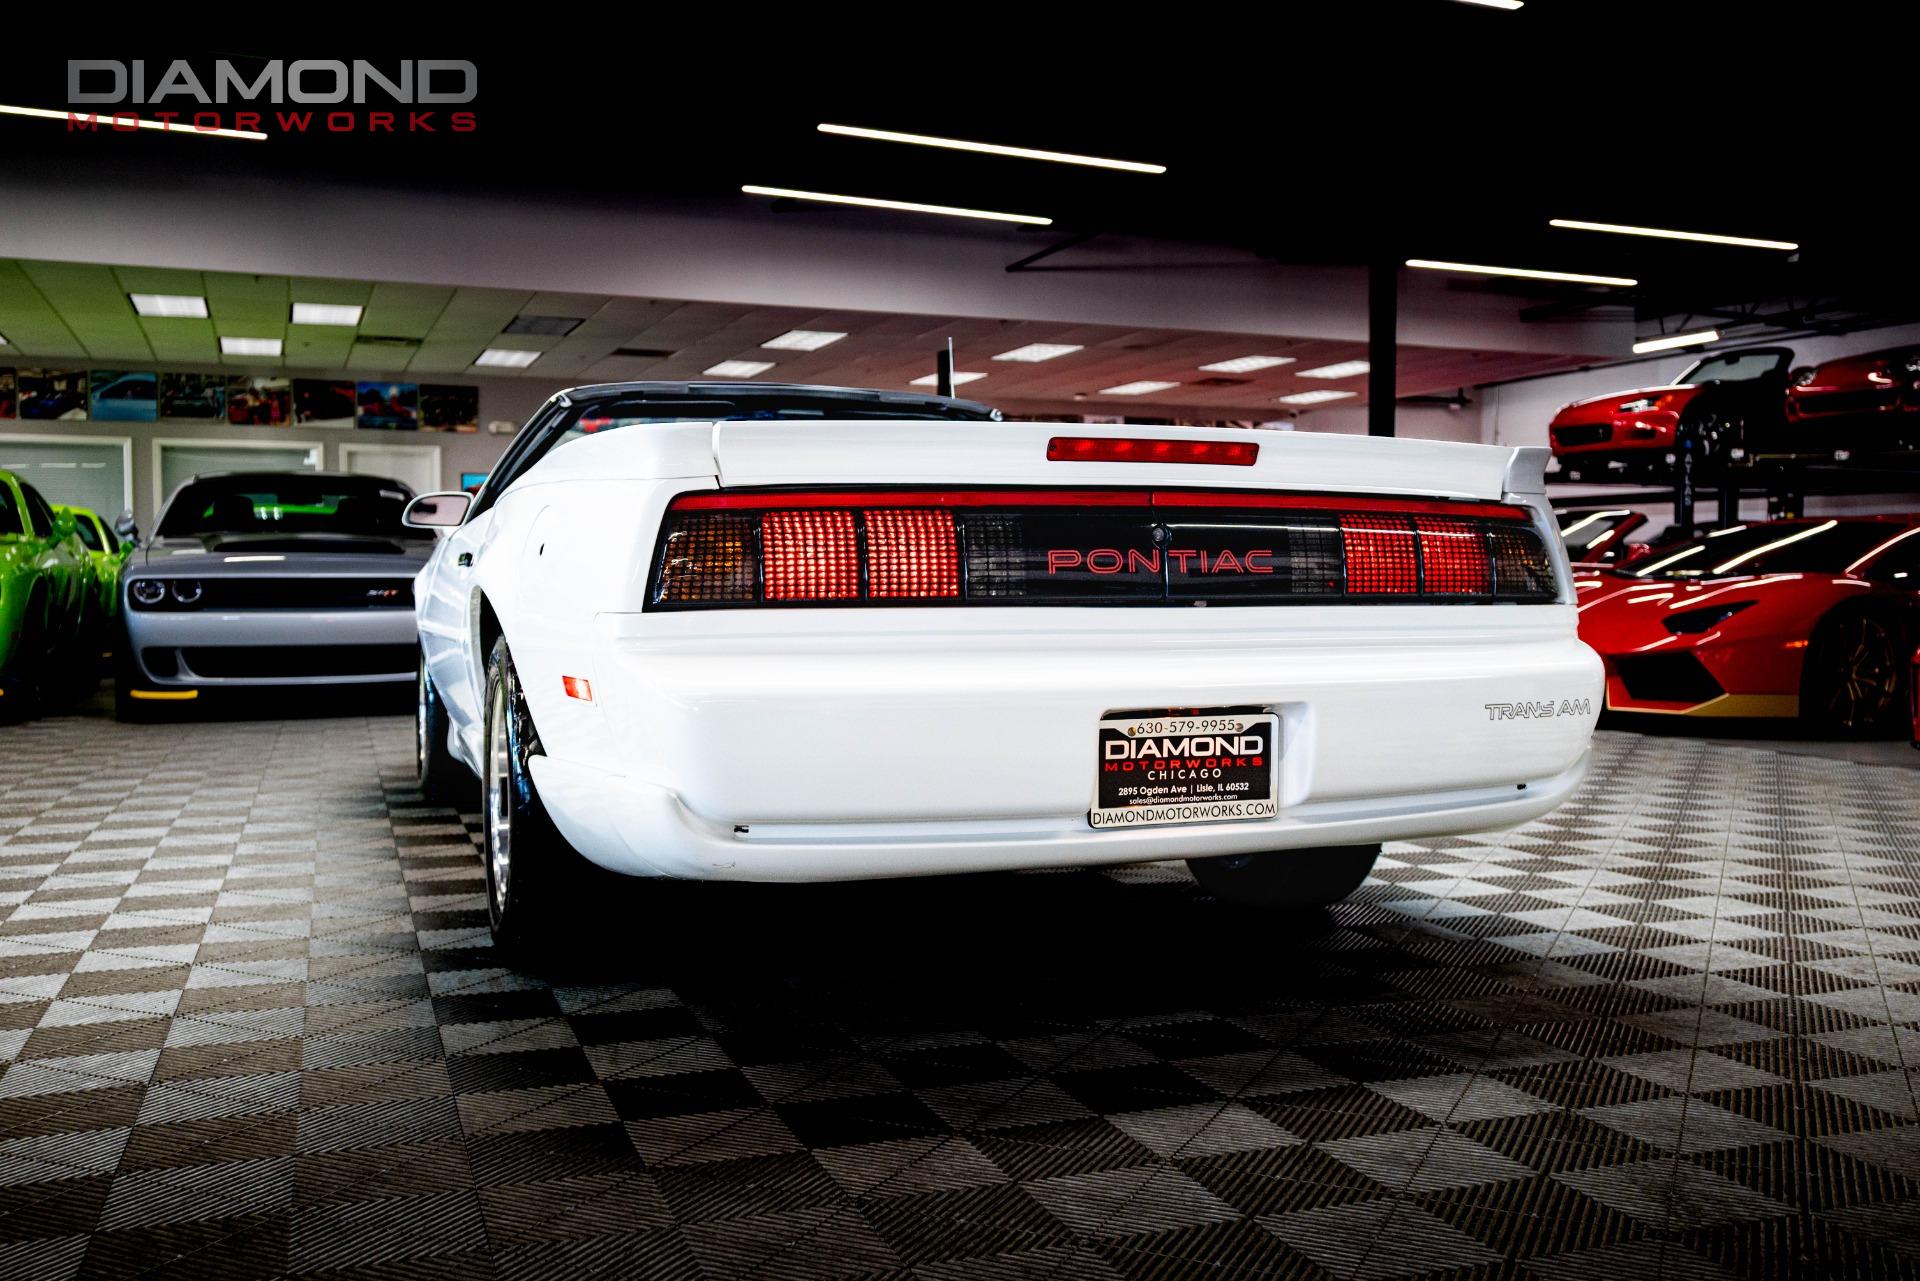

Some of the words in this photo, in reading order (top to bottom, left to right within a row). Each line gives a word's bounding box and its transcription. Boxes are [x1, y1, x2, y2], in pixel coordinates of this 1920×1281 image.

[1047, 549, 1273, 575] PONTIAC
[1485, 700, 1555, 720] TRANS
[1557, 698, 1591, 716] AM
[1136, 719, 1235, 735] 630-579-9955
[1105, 735, 1264, 760] DIAMOND
[1104, 756, 1263, 772] MOTORWORKS
[1147, 768, 1222, 781] CHICAGO
[1118, 787, 1138, 796] 2895
[1139, 785, 1169, 797] Ogden
[1170, 784, 1187, 794] Ave
[1196, 783, 1215, 793] Lisle,
[1217, 782, 1225, 791] IL
[1225, 782, 1249, 792] 60532
[1129, 793, 1238, 805] sales@diamondmotorworks.com
[1093, 803, 1275, 825] DIAMONDMOTORWORKS.COM
